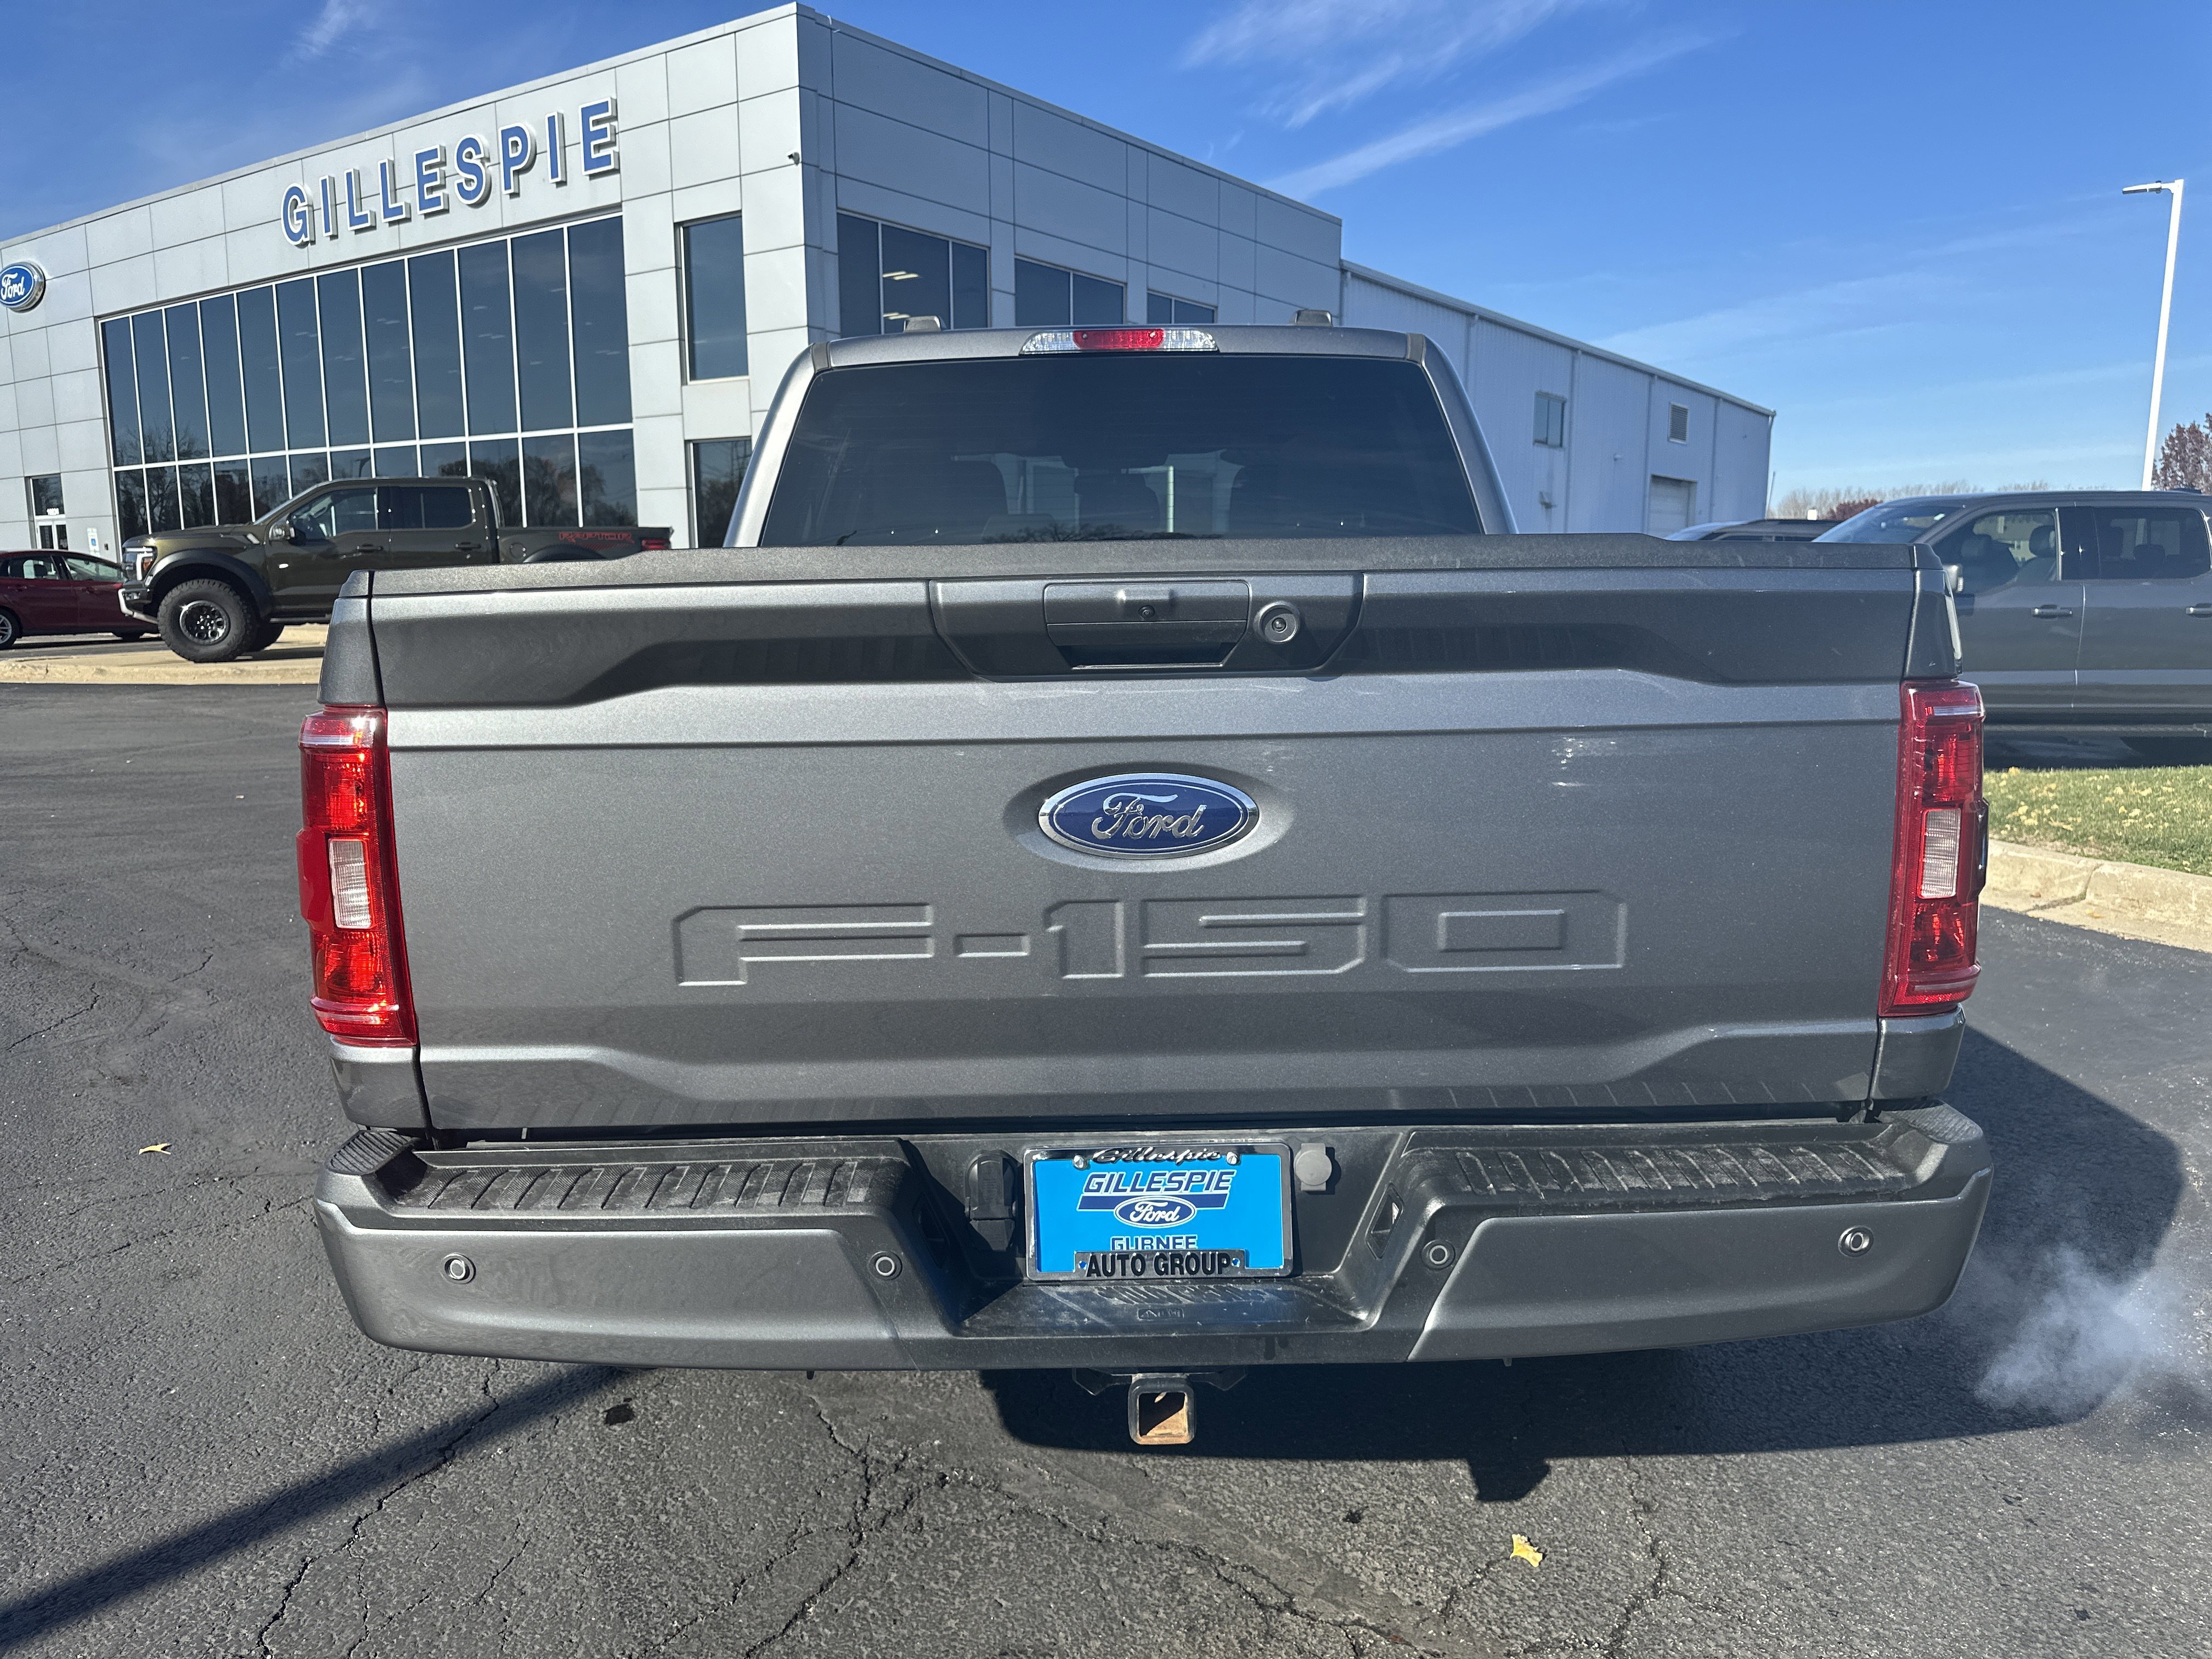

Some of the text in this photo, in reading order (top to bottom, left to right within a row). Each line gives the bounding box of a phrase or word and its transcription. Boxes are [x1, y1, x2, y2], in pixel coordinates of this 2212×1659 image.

[280, 97, 618, 245] GILLESPIE
[1, 272, 25, 300] Ford
[559, 532, 634, 543] RAPTOR
[1091, 792, 1207, 839] Ford
[674, 890, 1627, 986] F-150
[1092, 1147, 1221, 1165] Gillespie
[1082, 1169, 1237, 1194] GILLESPIE
[1129, 1201, 1181, 1222] Ford
[1110, 1234, 1198, 1251] GURNEE
[1086, 1251, 1231, 1277] AUTO GROUP
